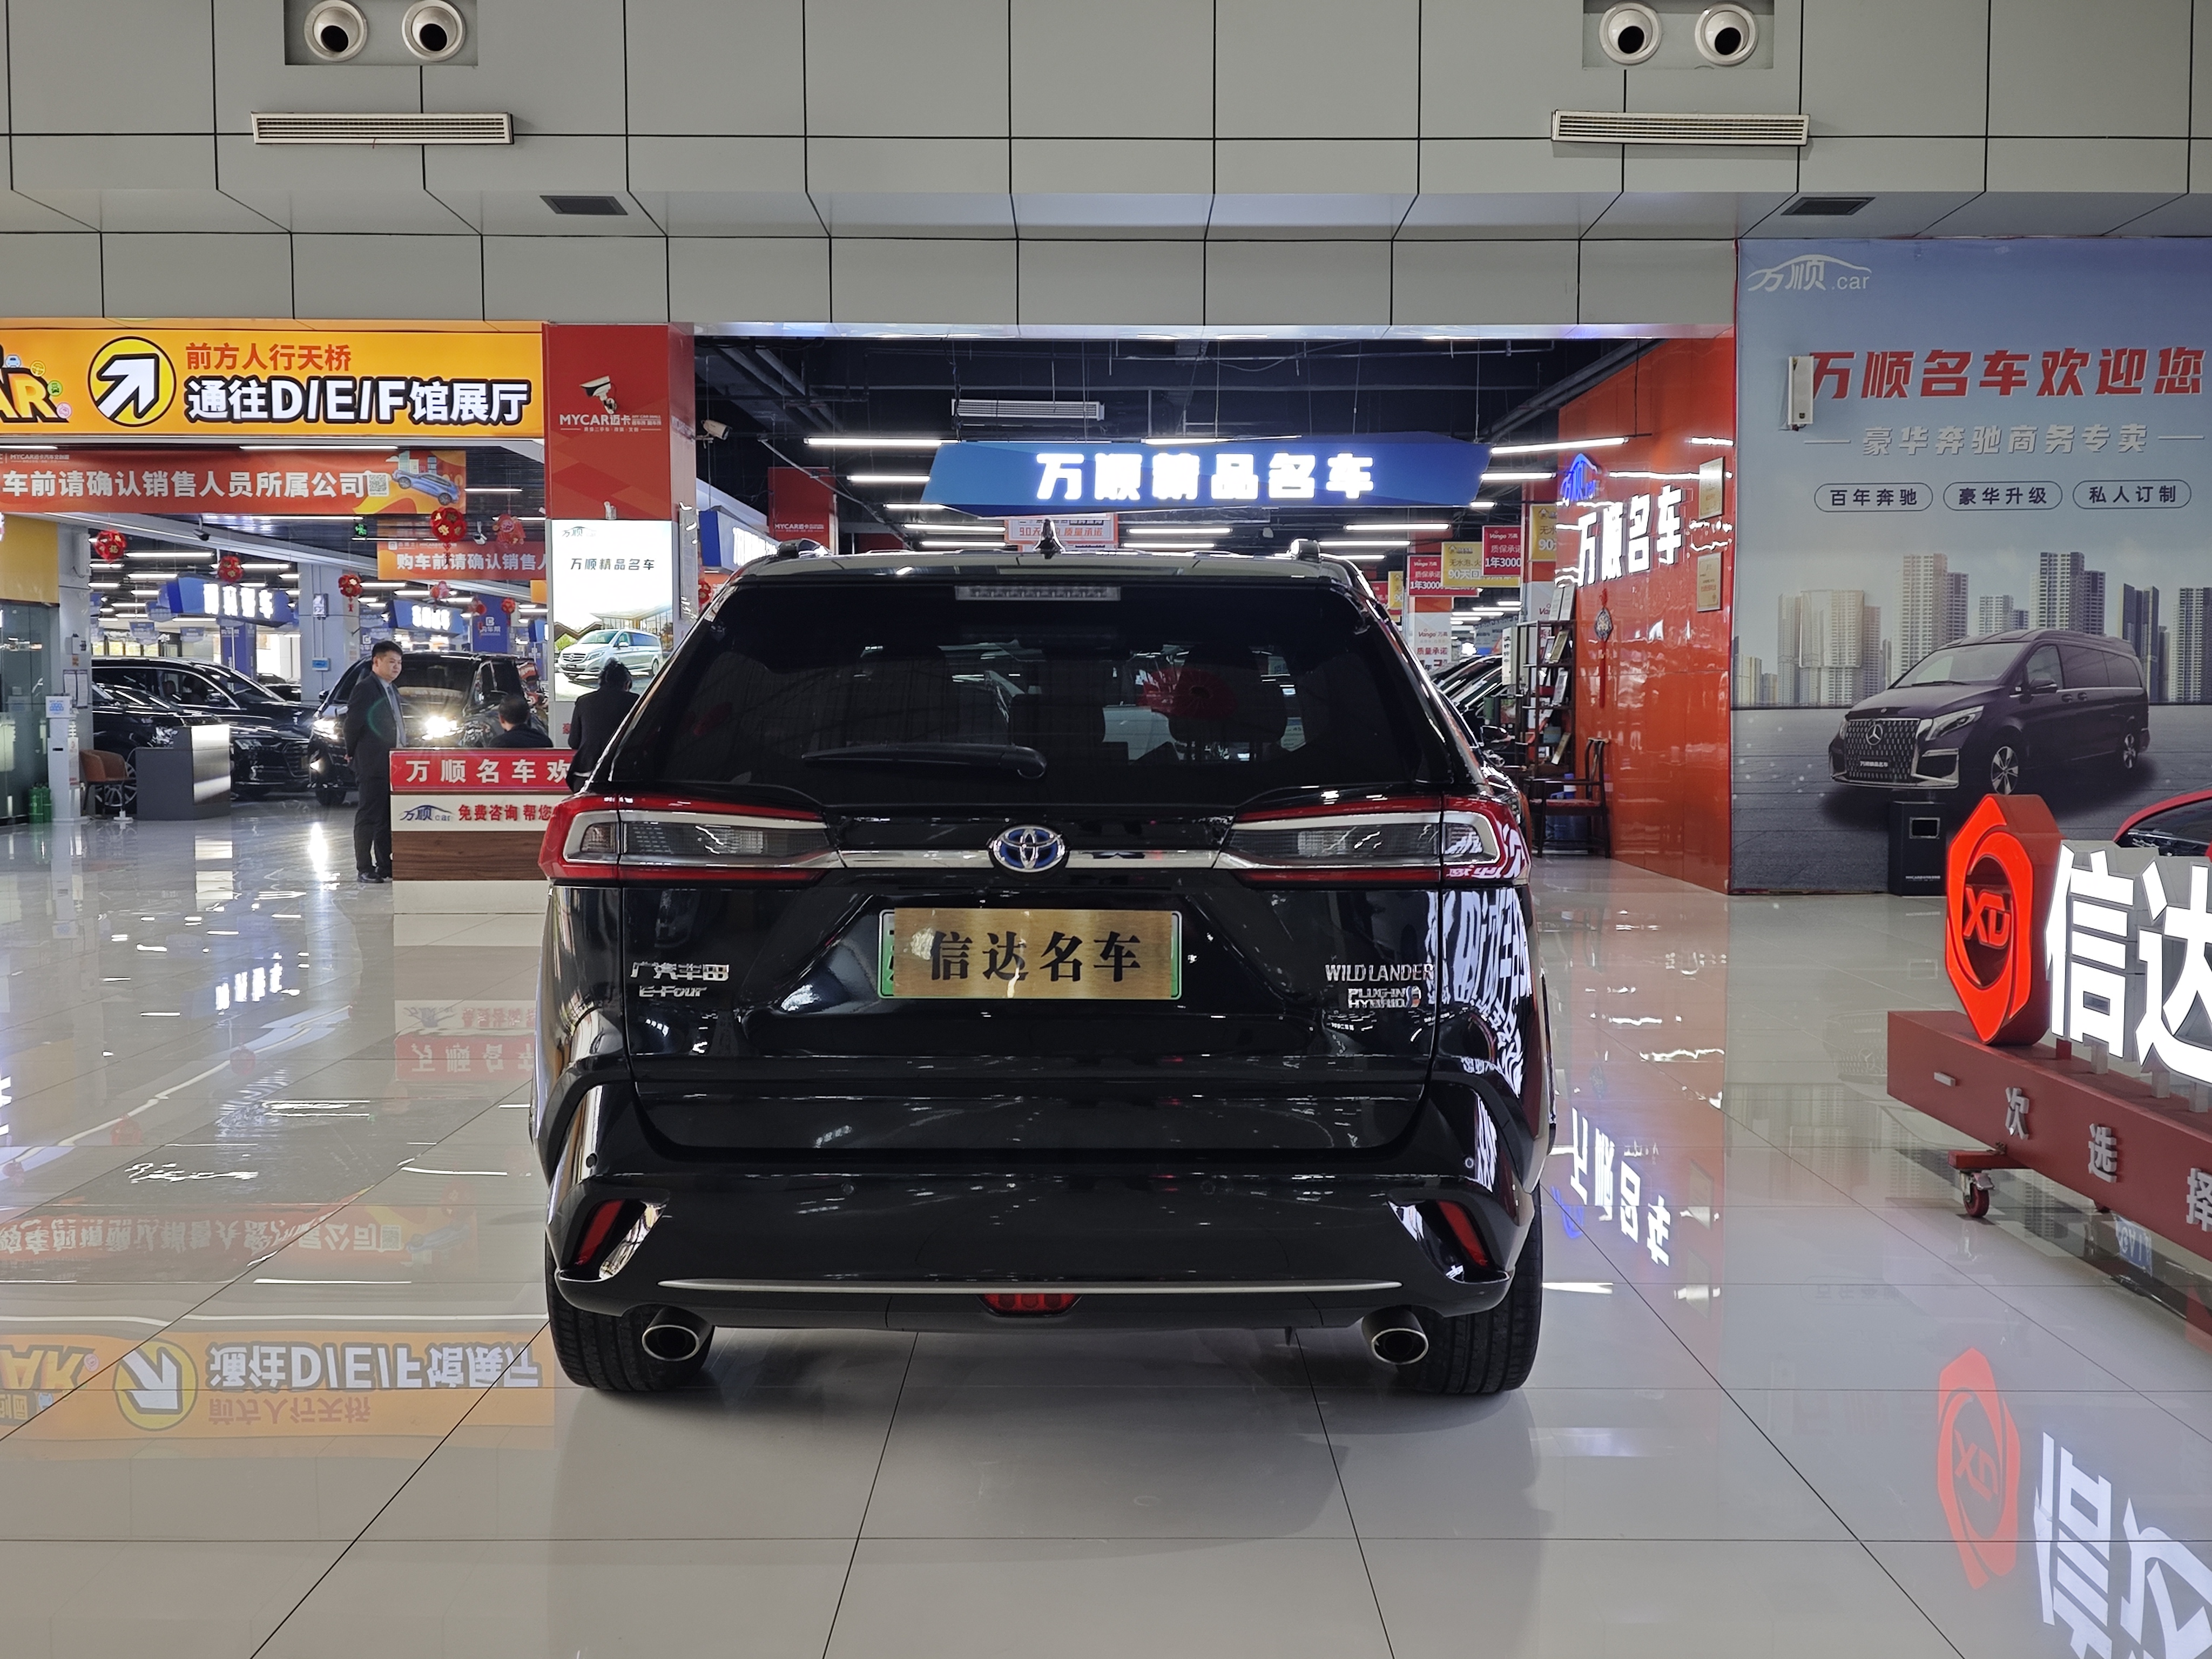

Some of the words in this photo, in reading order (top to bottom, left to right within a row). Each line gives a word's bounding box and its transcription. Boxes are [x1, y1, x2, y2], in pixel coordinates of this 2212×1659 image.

[1748, 260, 1827, 292] 万顺
[186, 342, 351, 372] 前方人行天桥
[1810, 346, 2205, 400] 万顺名车欢迎您
[187, 379, 529, 422] 通往D/E/F馆展厅
[1861, 423, 2148, 457] 豪华奔驰商务专卖
[2, 470, 363, 498] 车前请确认销售人员所属公司
[1036, 453, 1374, 499] 万顺精品名车
[1830, 488, 1918, 507] 百年奔驰
[1958, 487, 2048, 505] 豪华升级
[2089, 484, 2177, 503] 私人订制
[1577, 484, 1682, 587] 万顺名车
[570, 558, 655, 570] 万顺精品名车
[1417, 647, 1447, 655] 质量承诺
[406, 759, 570, 784] 万顺名车欢
[400, 806, 433, 821] 万顺
[458, 804, 517, 821] 免费咨询
[523, 804, 557, 821] 帮您
[930, 930, 1141, 982] 信达名车
[630, 961, 729, 981] 广汽丰田
